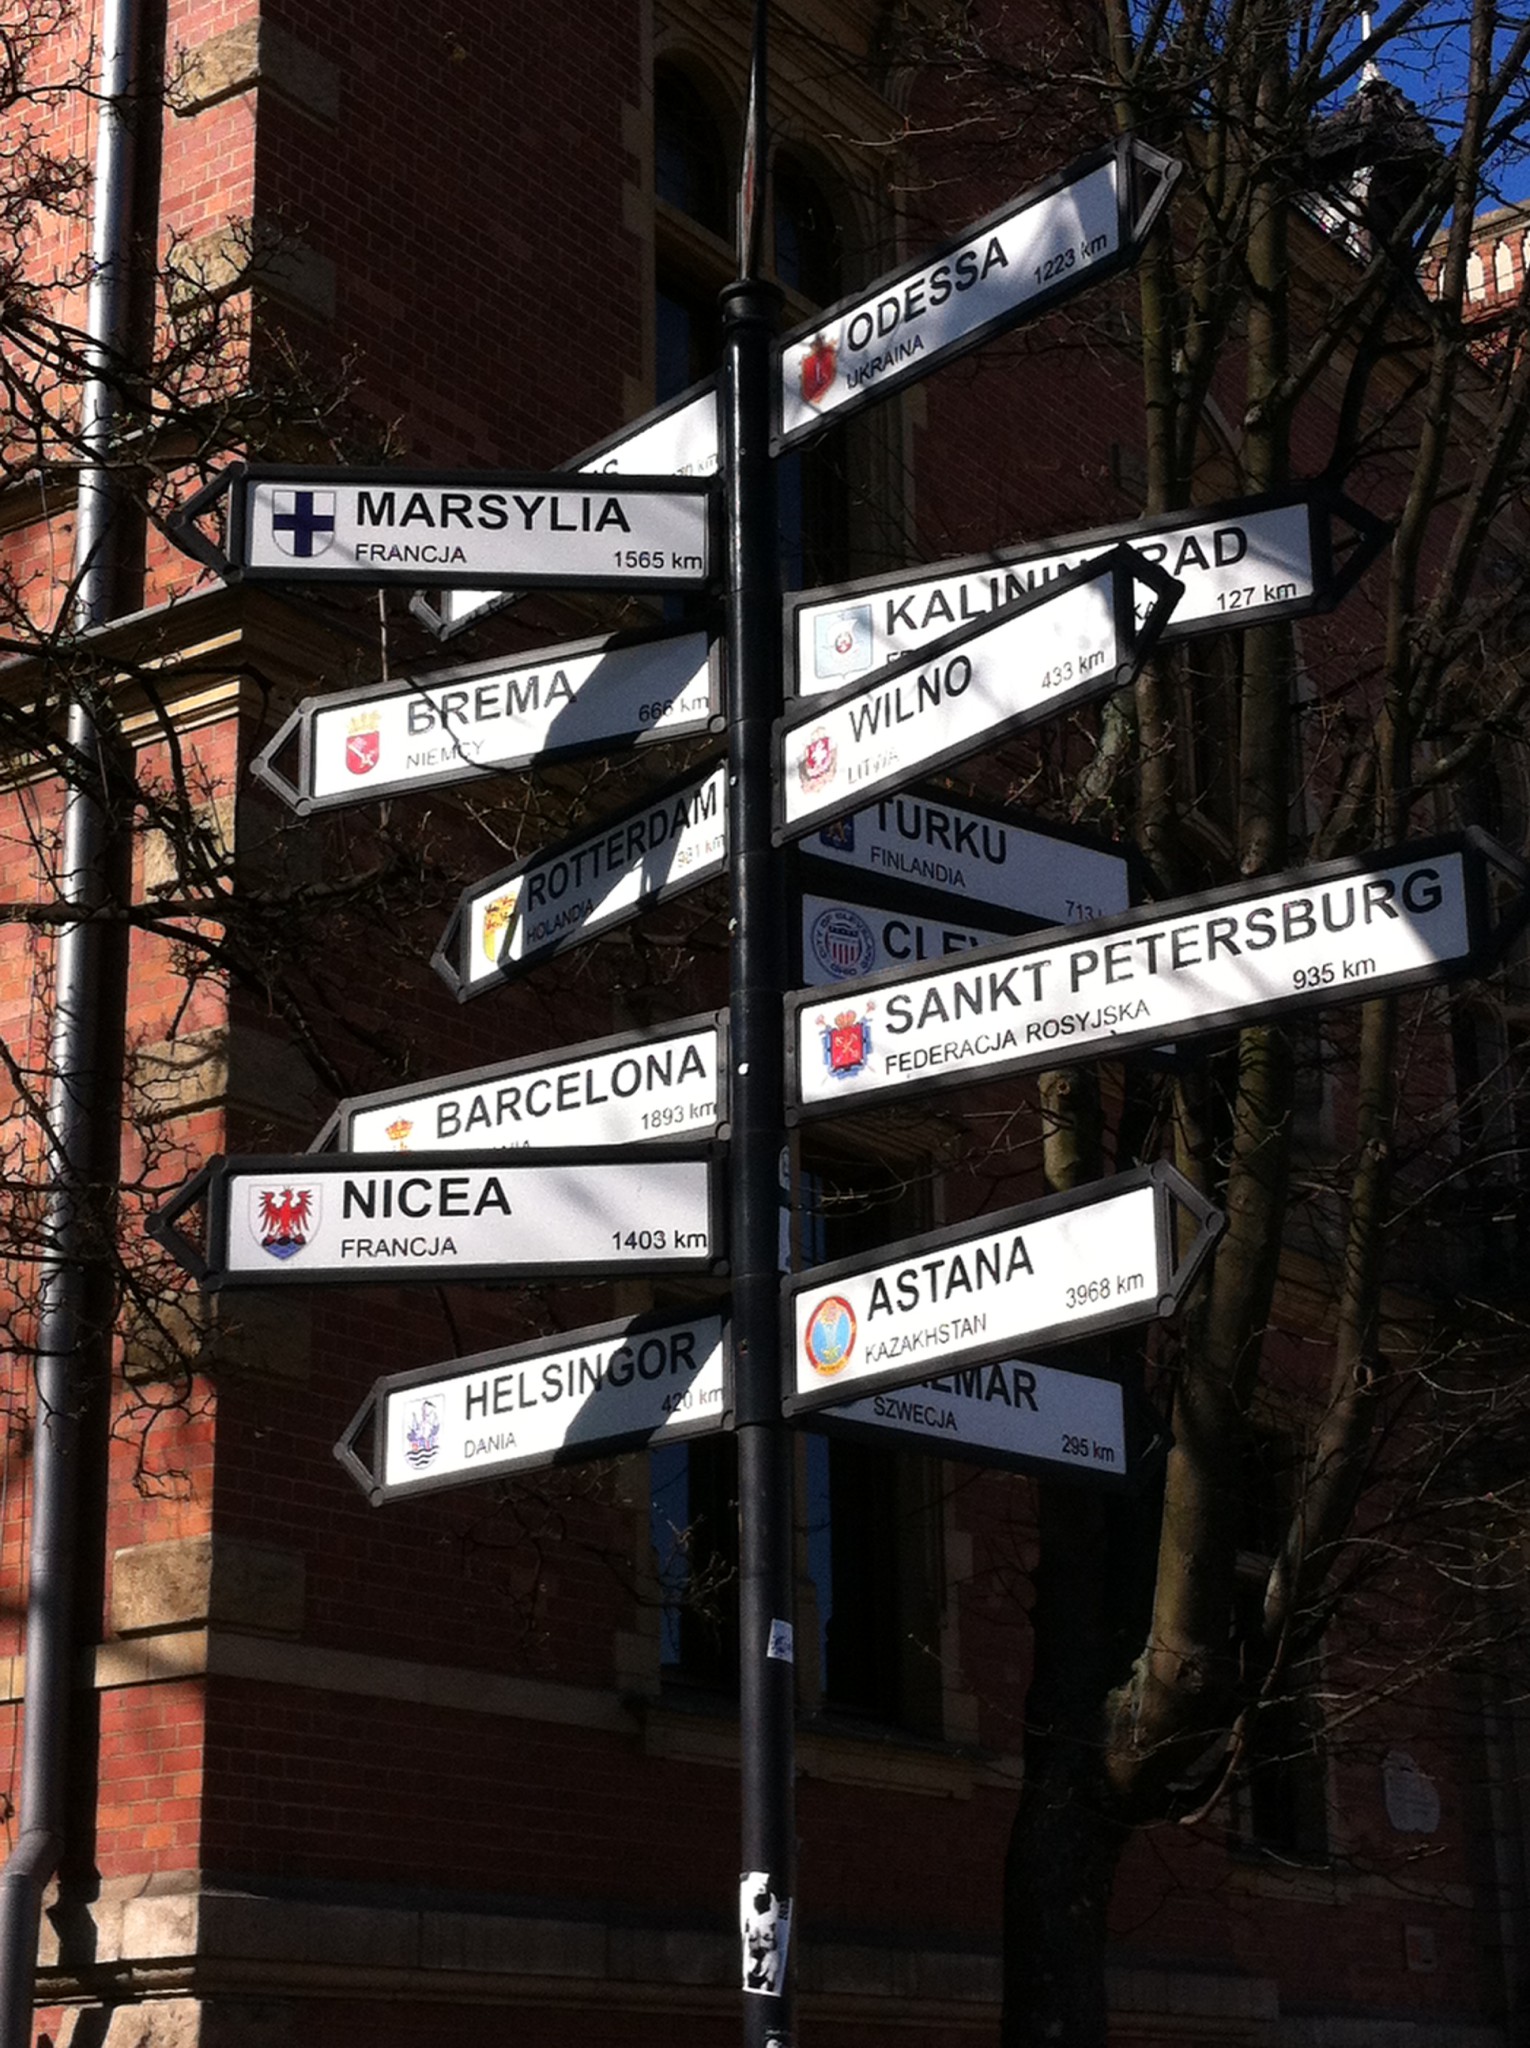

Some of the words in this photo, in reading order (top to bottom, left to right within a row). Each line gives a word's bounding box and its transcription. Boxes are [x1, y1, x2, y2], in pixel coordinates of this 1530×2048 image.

[1033, 249, 1076, 286] 1223
[1081, 232, 1108, 261] km
[847, 236, 1009, 352] ODESSA
[847, 335, 924, 389] UKRAINA
[356, 491, 631, 534] MARSYLIA
[355, 543, 467, 564] FRANCJA
[614, 552, 665, 569] 1565
[672, 552, 703, 570] km
[1216, 588, 1255, 611] 127
[1264, 579, 1297, 603] km
[1041, 662, 1073, 689] 433
[1079, 650, 1105, 674] km
[408, 670, 577, 736] BREMA
[638, 699, 674, 722] 666
[680, 696, 709, 712] km
[849, 655, 972, 742] WILNO
[527, 781, 717, 912] ROTTERDAM
[874, 800, 1007, 865] TURKU
[870, 845, 965, 889] FINLANDIA
[527, 898, 595, 945] HOLANDIA
[1065, 900, 1094, 920] 713
[885, 960, 1053, 1036] SANKT
[1070, 867, 1444, 993] PETERSBURG
[1292, 961, 1335, 992] 935
[1341, 953, 1377, 981] km
[884, 1028, 1019, 1075] FEDERACJA
[1026, 999, 1151, 1046] ROSYJSKA
[436, 1045, 707, 1139] BARCELONA
[641, 1106, 685, 1130] 1893
[689, 1101, 717, 1120] km
[342, 1176, 512, 1220] NICEA
[341, 1237, 457, 1258] FRANCJA
[612, 1230, 667, 1251] 1403
[673, 1230, 708, 1250] km
[866, 1235, 1034, 1322] ASTANA
[1065, 1280, 1111, 1309] 3968
[1117, 1270, 1145, 1294] km
[865, 1312, 988, 1364] KAZAKHSTAN
[464, 1331, 697, 1422] HELSINGOR
[661, 1388, 693, 1412] 420
[699, 1387, 723, 1405] km
[873, 1396, 958, 1431] SZWECJA
[464, 1431, 517, 1460] DANIA
[1061, 1434, 1089, 1458] 295
[1093, 1441, 1115, 1463] km
